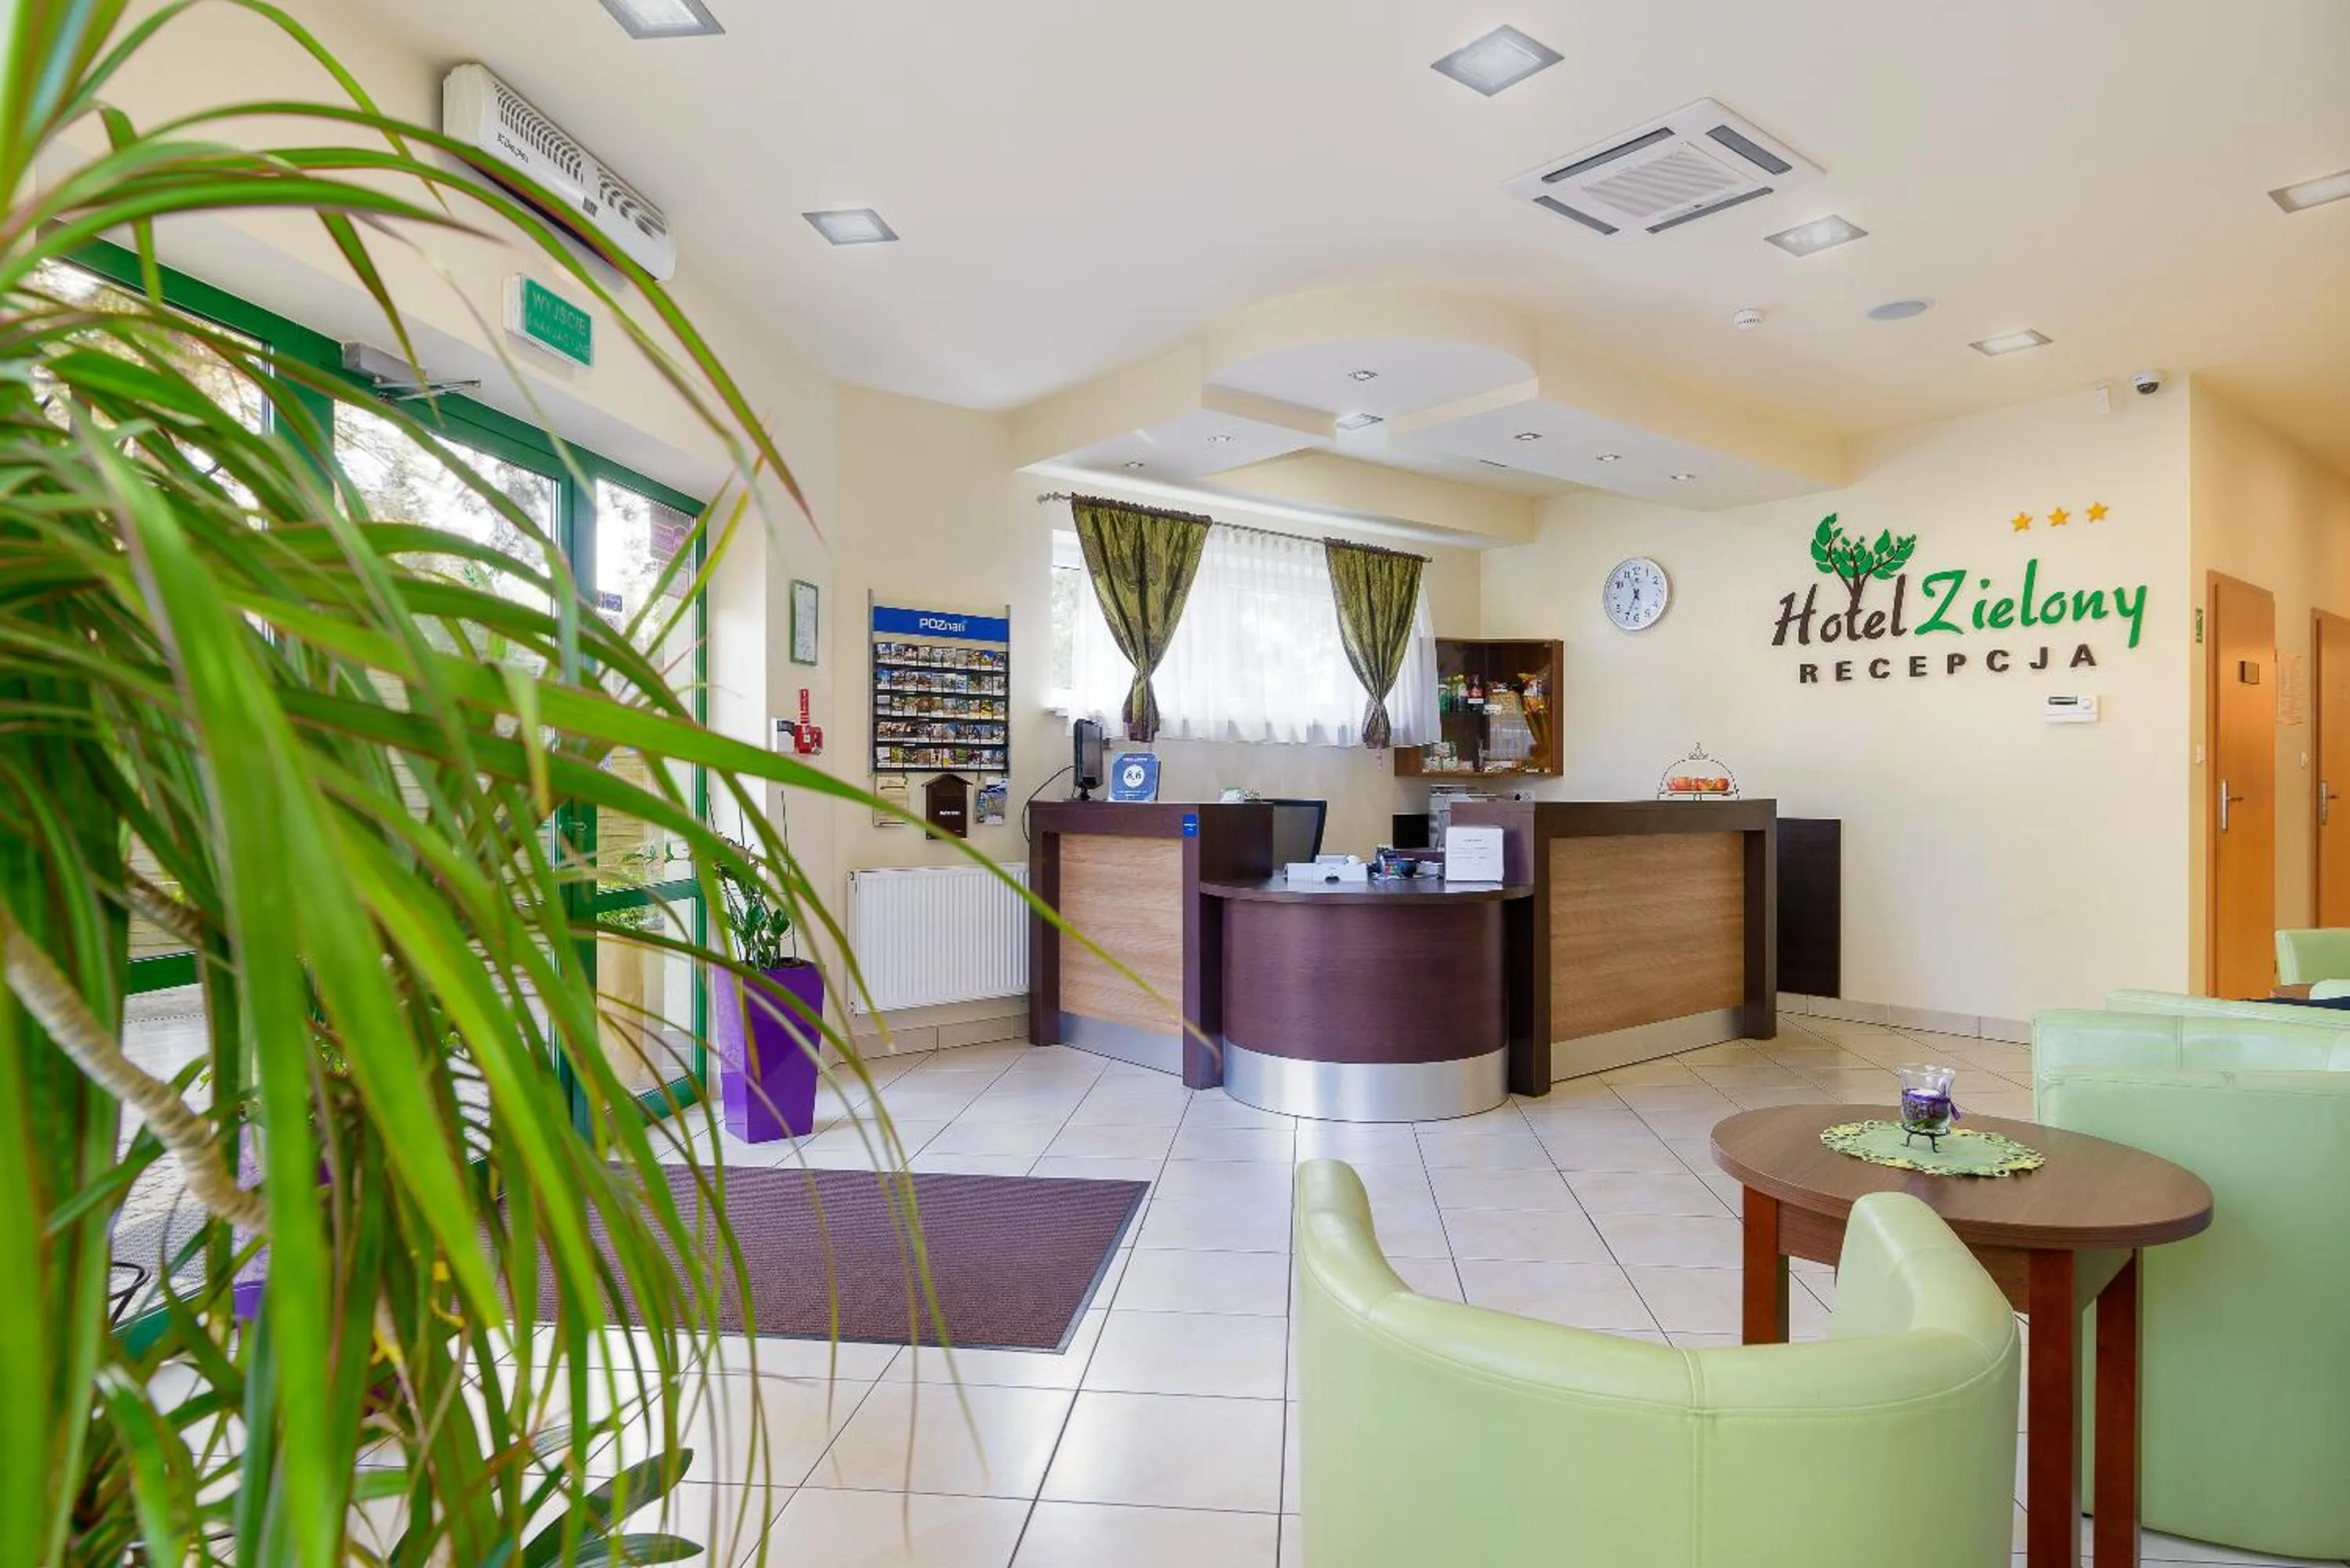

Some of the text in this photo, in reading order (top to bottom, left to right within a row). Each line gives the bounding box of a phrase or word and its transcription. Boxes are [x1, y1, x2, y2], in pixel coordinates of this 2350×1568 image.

[1772, 574, 1908, 646] Hotel
[1914, 559, 2148, 649] Zielony
[1798, 643, 2098, 684] RECEPCJA
